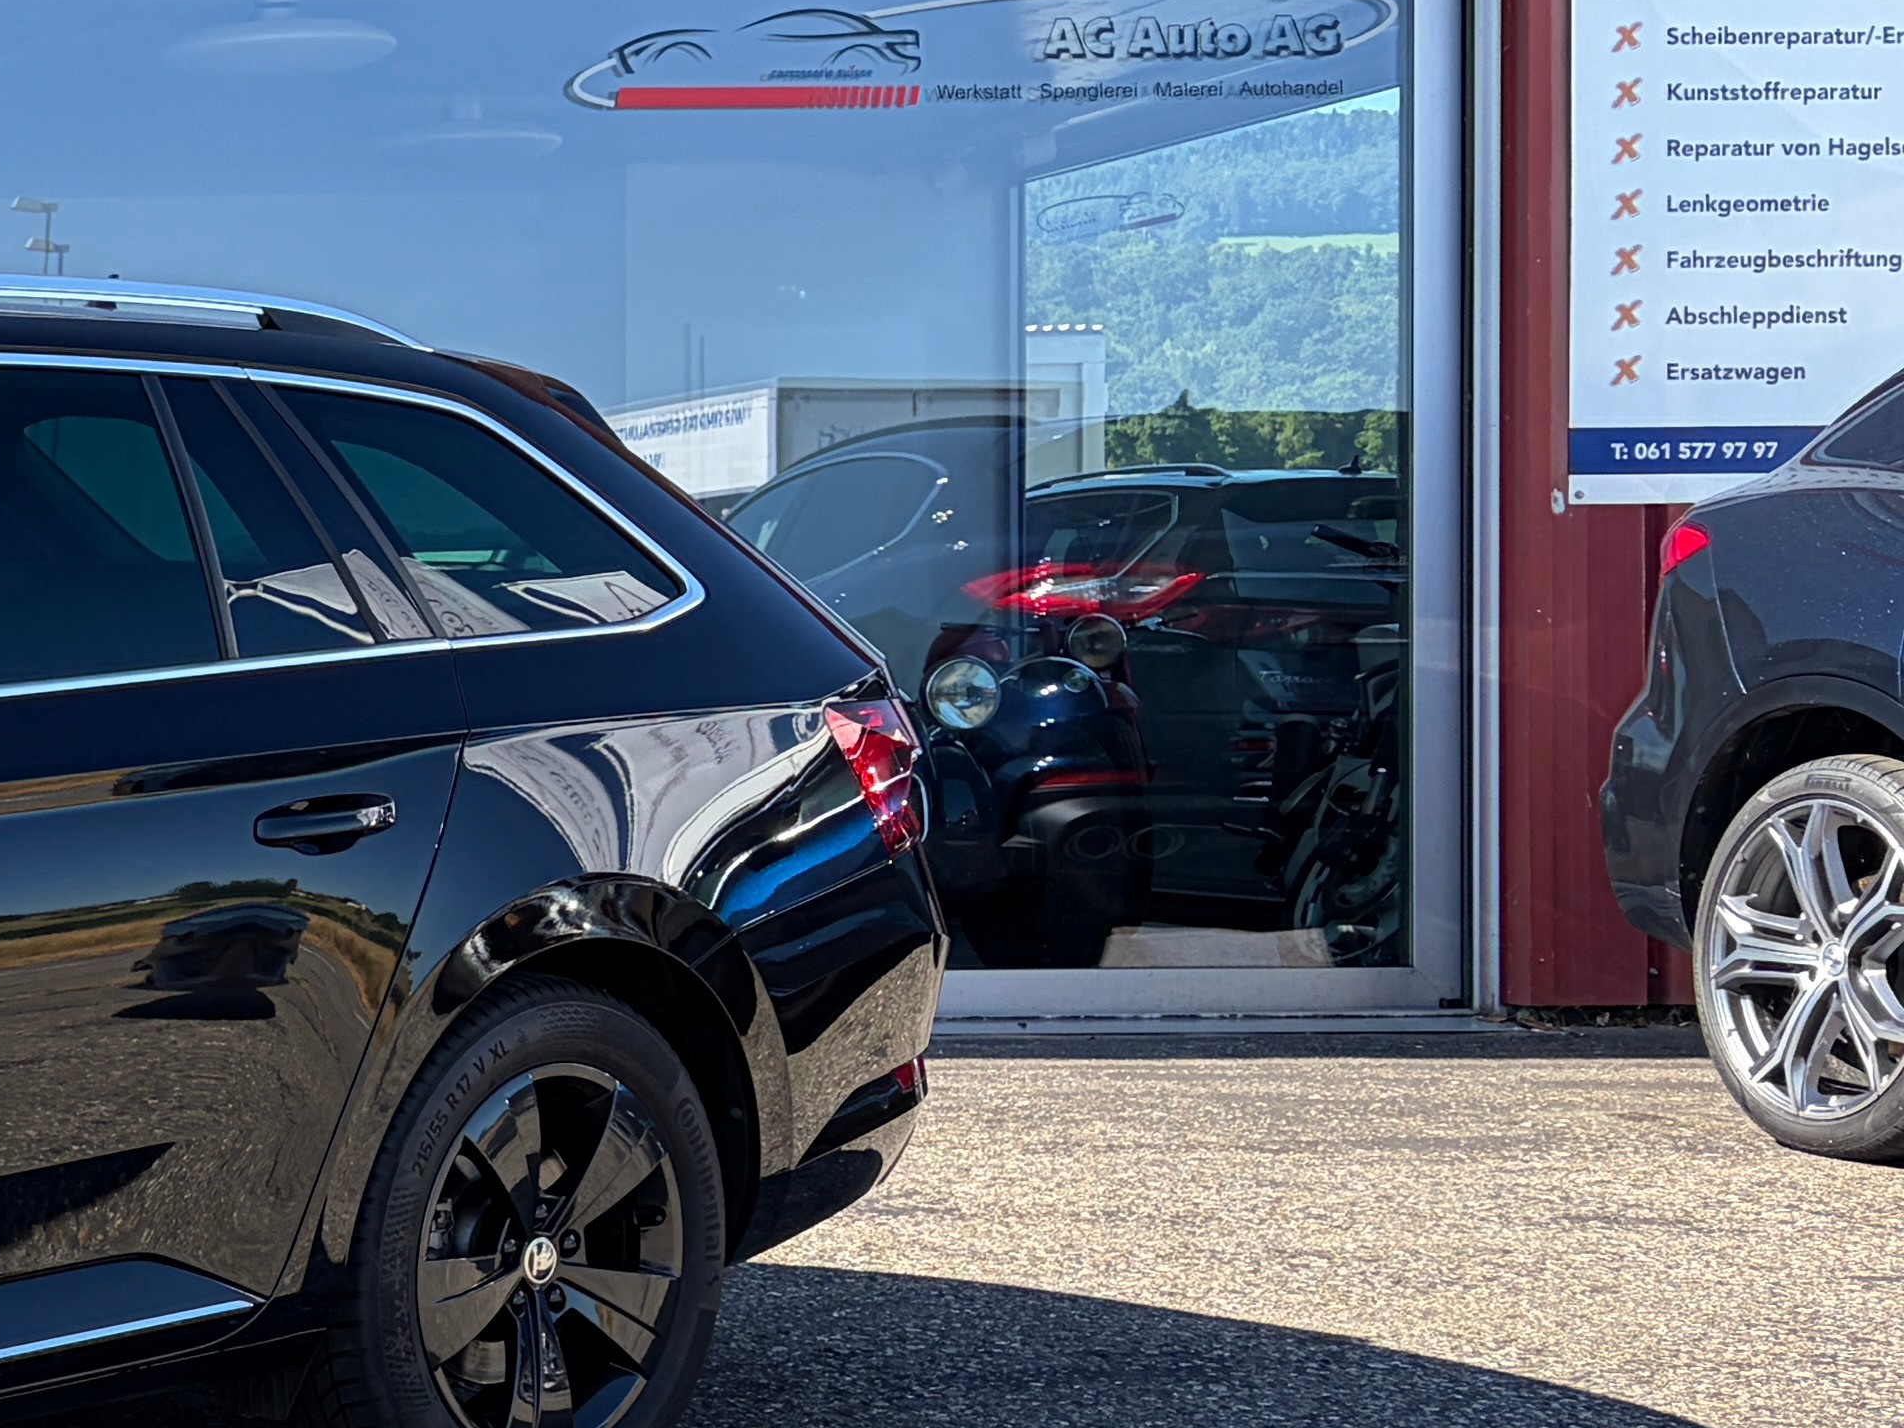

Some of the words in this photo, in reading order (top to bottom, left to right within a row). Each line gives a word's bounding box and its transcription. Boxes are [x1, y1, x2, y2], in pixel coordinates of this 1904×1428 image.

[1042, 16, 1115, 59] AC
[1127, 16, 1252, 59] Auto
[1263, 13, 1342, 57] AG
[936, 83, 1022, 100] Werkstatt
[1039, 82, 1138, 103] Spenglerei
[1155, 81, 1223, 98] Malerei
[1239, 79, 1344, 96] Autohandel
[1667, 80, 1882, 105] Kunststoffreparatur
[1667, 138, 1775, 162] Reparatur
[1781, 142, 1820, 158] von
[1667, 193, 1830, 217] Lenkgeometrie
[1667, 248, 1904, 273] Fahrzeugbeschriftung
[1665, 304, 1848, 329] Abschleppdienst
[1666, 362, 1806, 385] Ersatzwagen
[1610, 442, 1629, 461] T:
[1635, 441, 1670, 461] 061
[1678, 441, 1715, 460] 577
[1722, 441, 1746, 460] 97
[1753, 441, 1778, 459] 97
